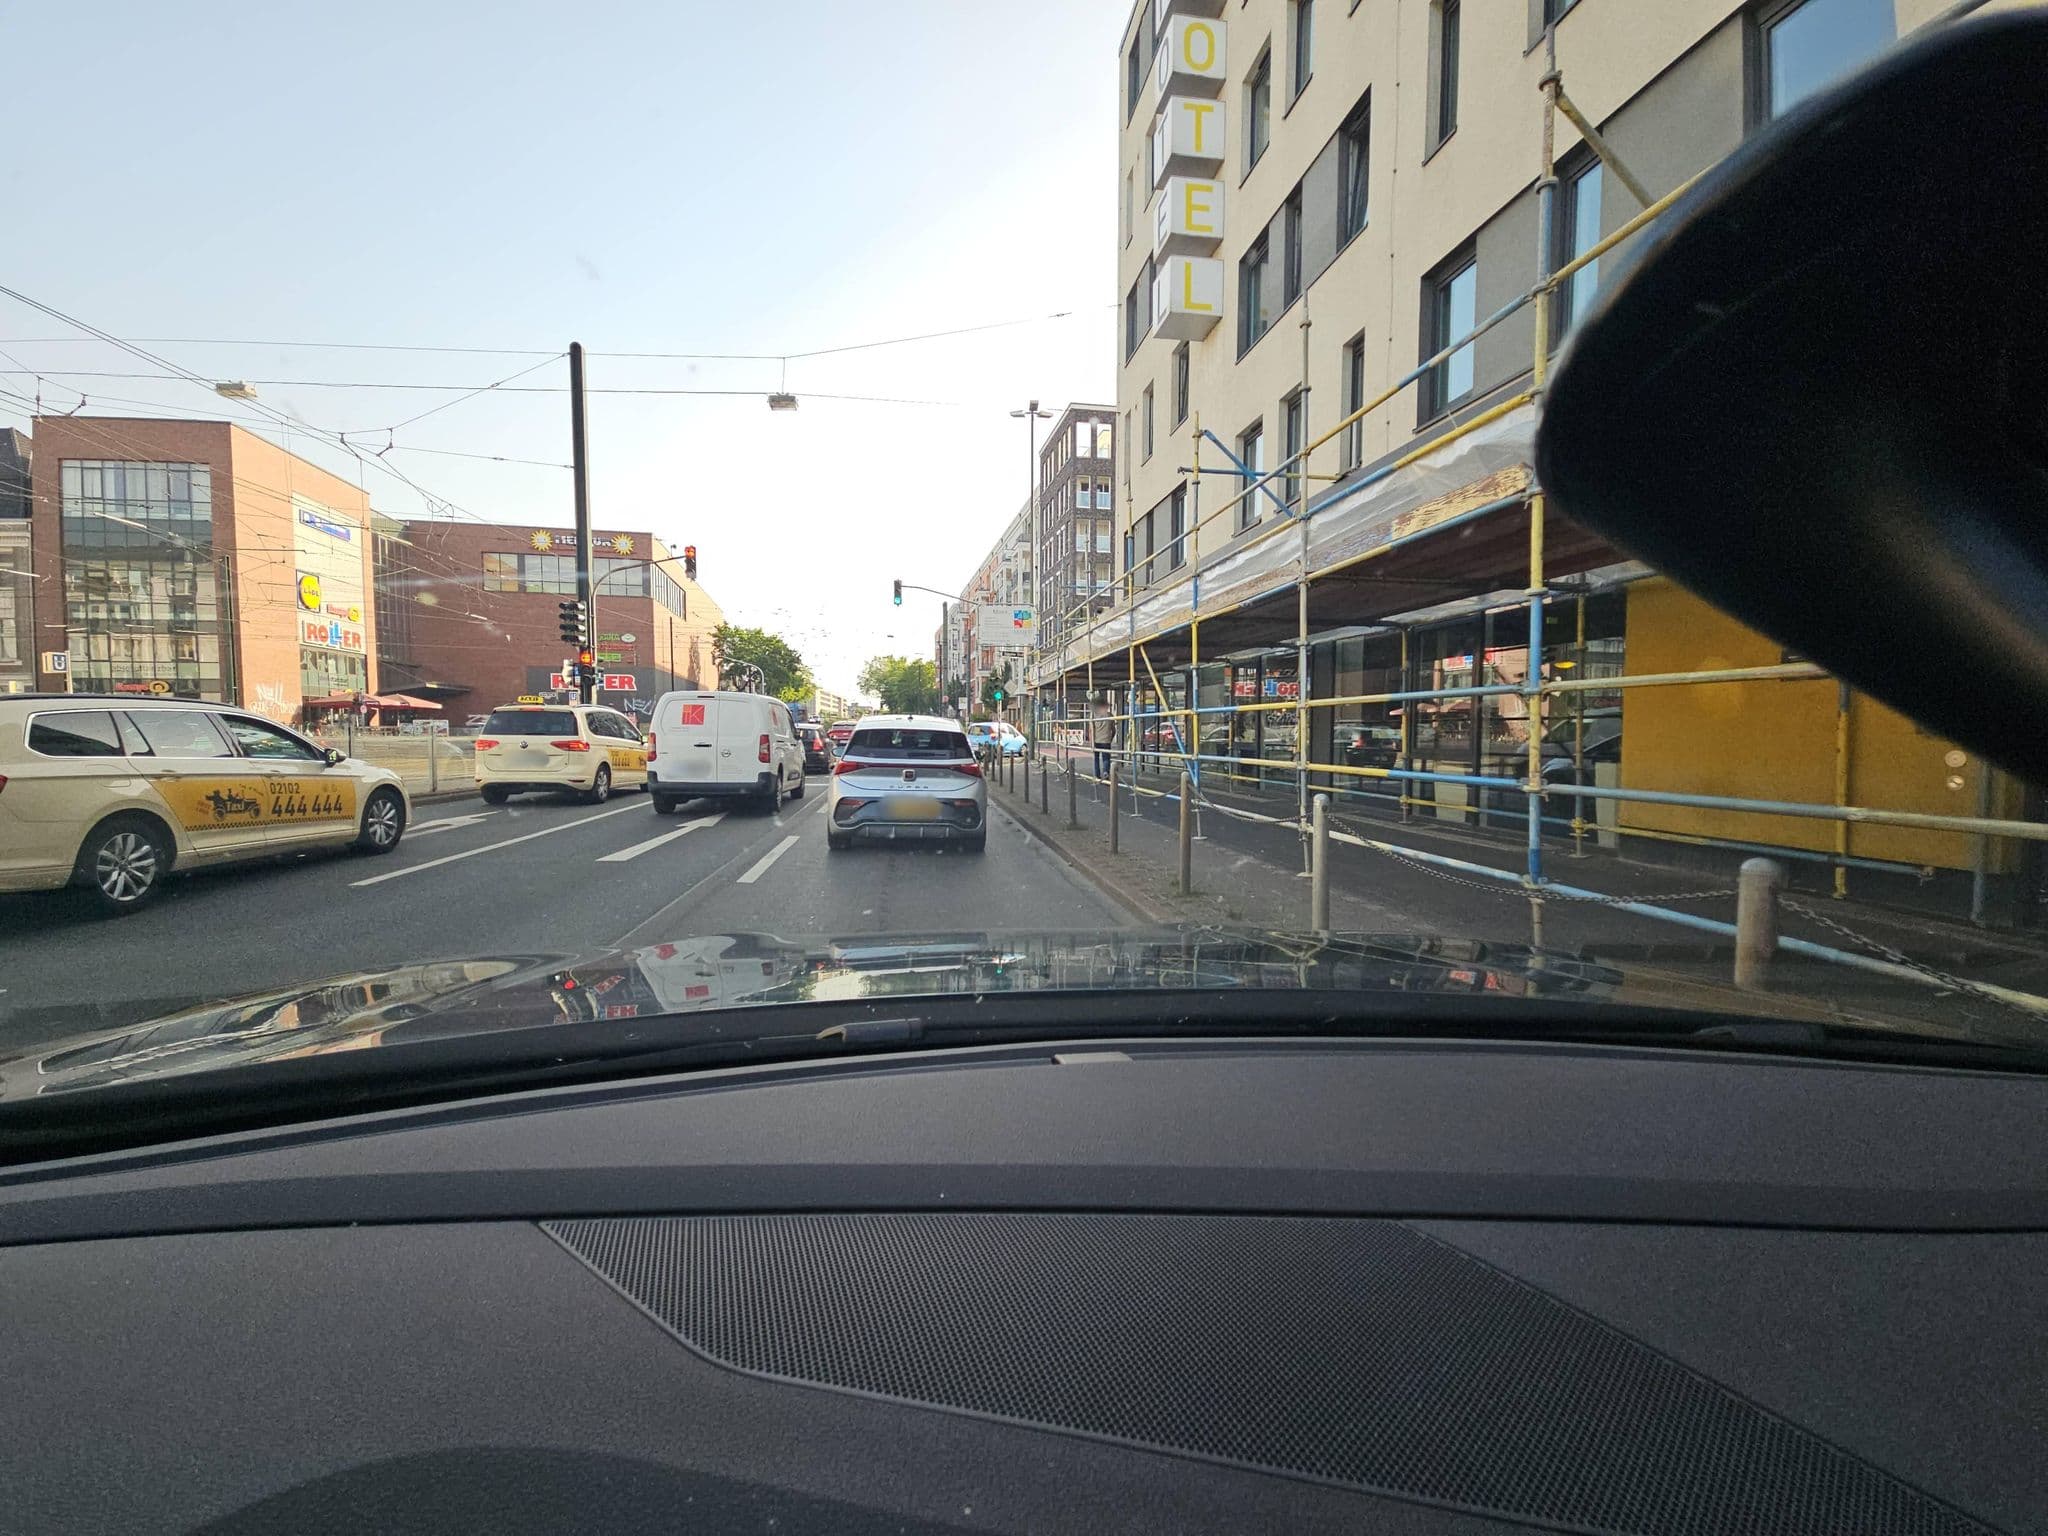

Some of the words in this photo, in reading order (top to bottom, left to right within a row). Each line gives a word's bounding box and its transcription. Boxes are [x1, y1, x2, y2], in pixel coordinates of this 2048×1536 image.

[306, 621, 362, 650] ROLLER
[53, 655, 66, 670] U
[270, 783, 300, 794] 02102
[227, 801, 245, 812] Taxi
[271, 795, 308, 817] 444
[311, 794, 343, 815] 444
